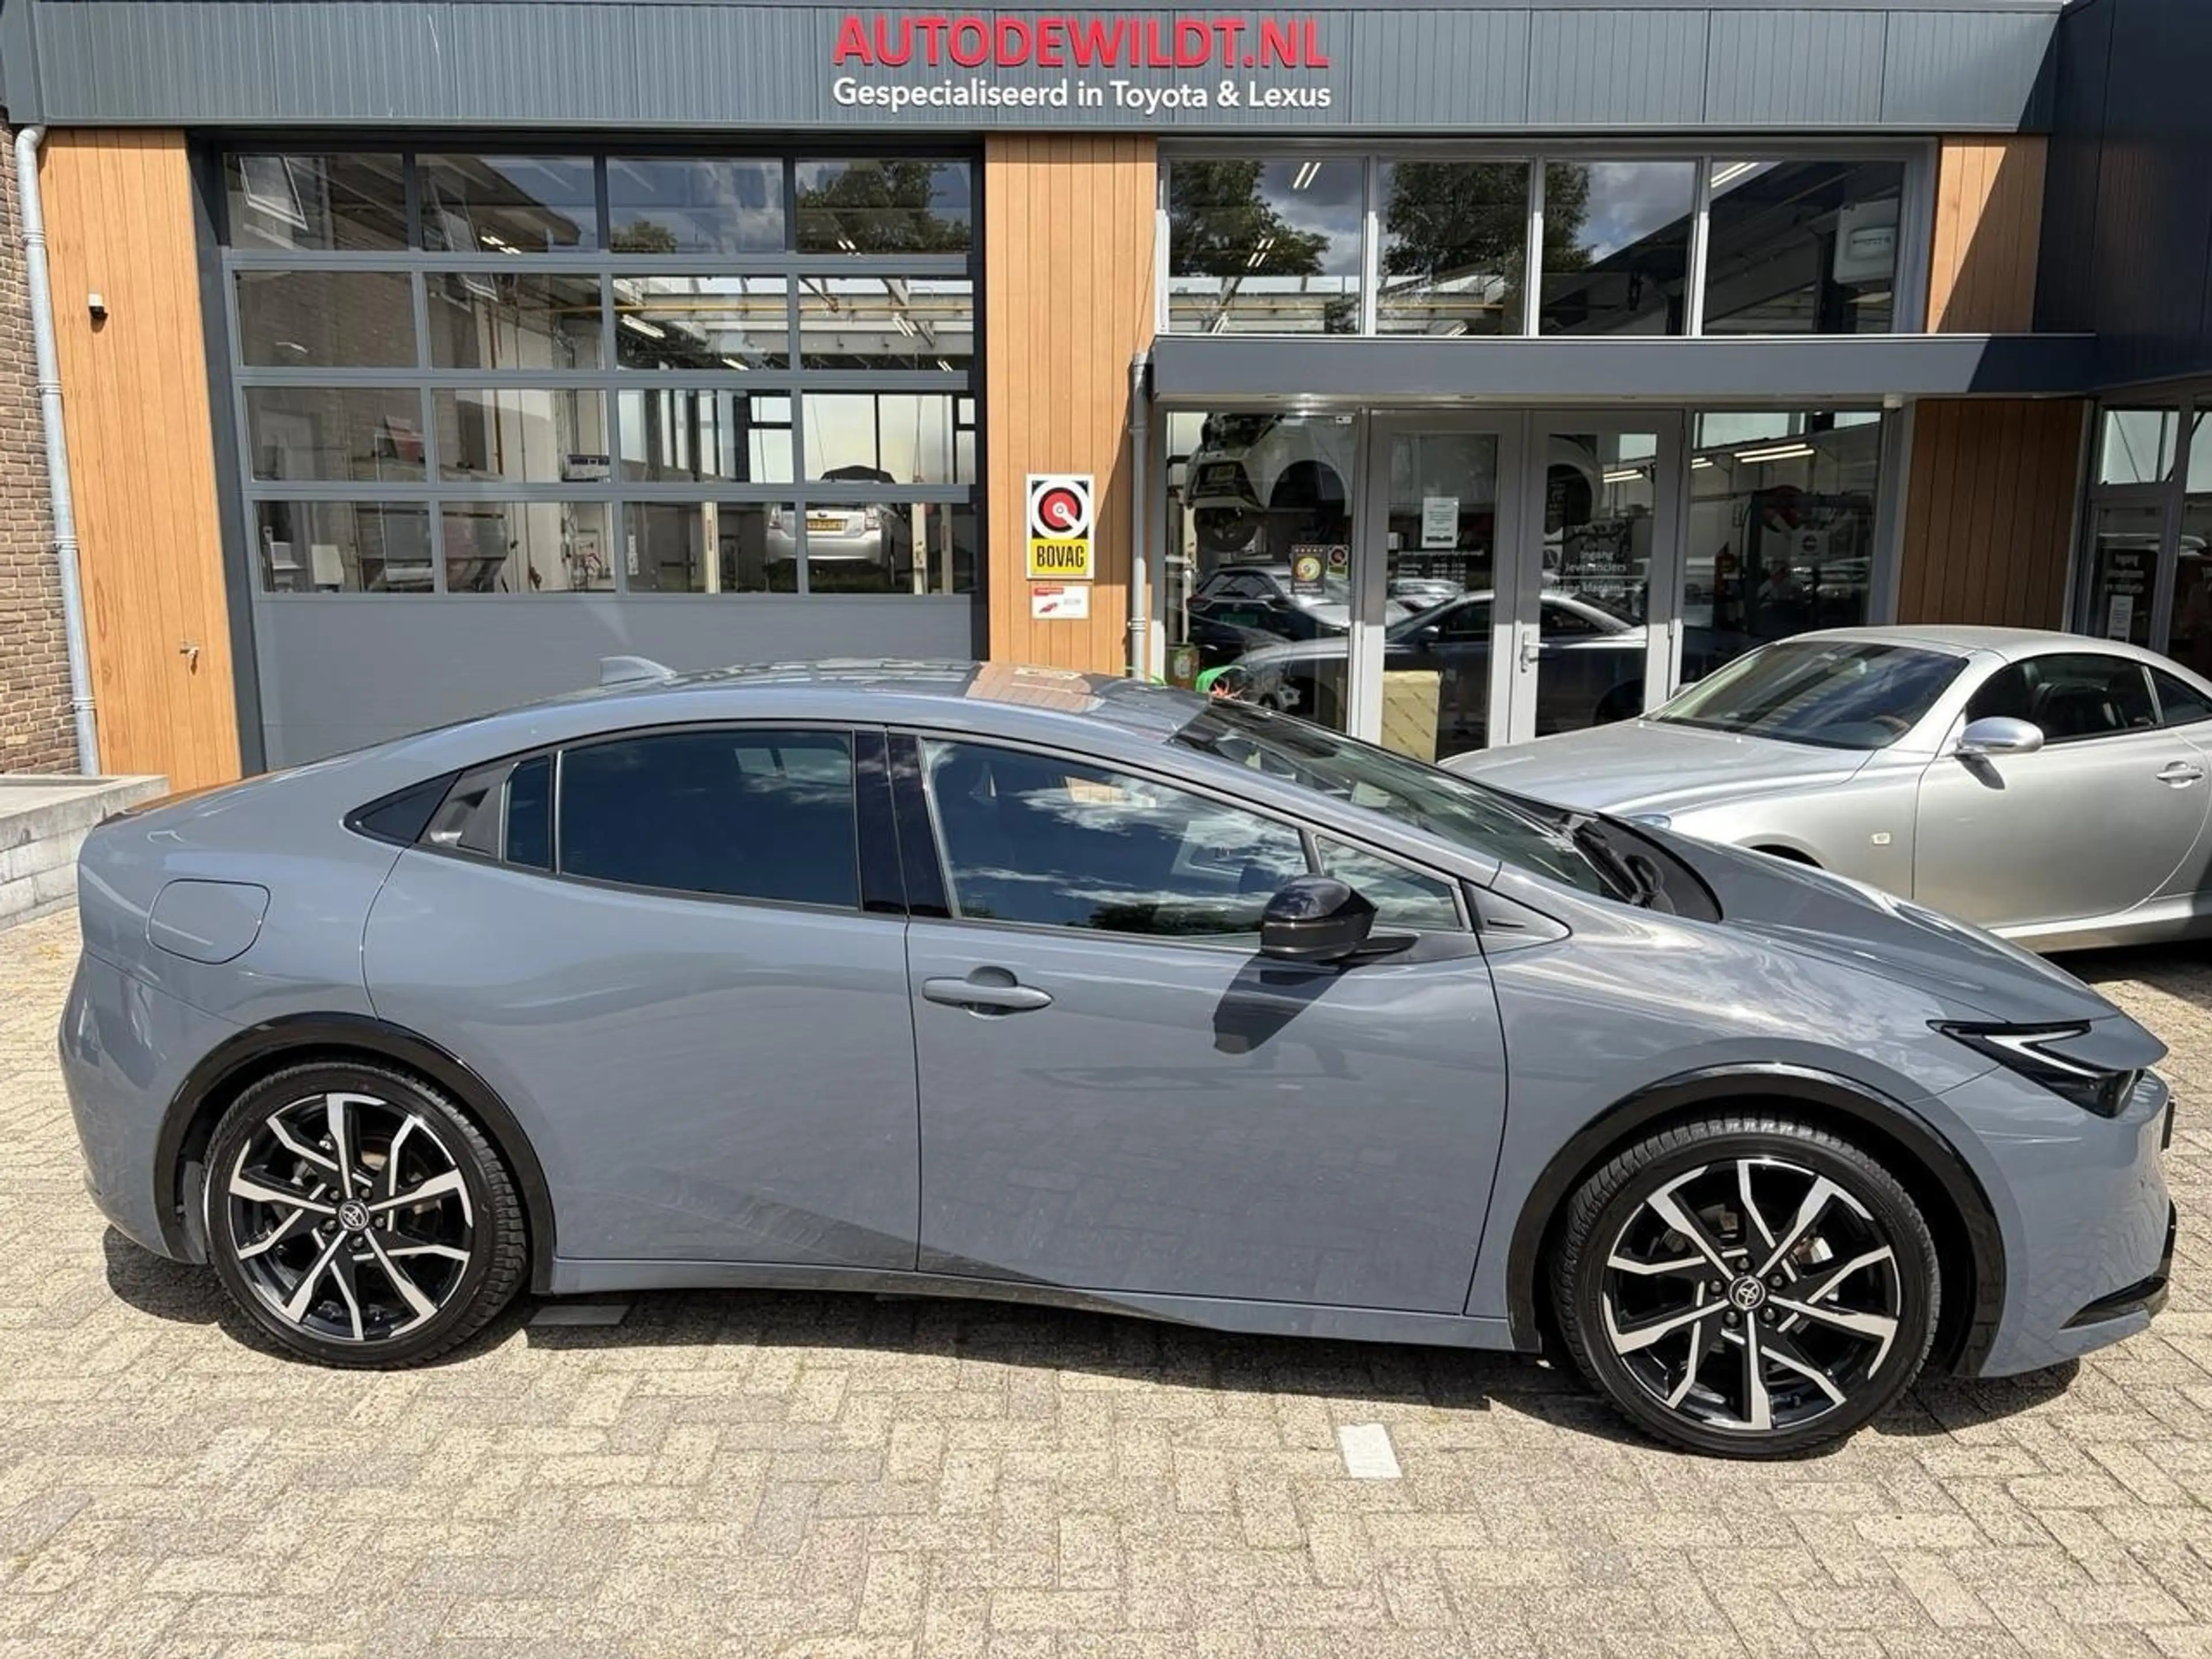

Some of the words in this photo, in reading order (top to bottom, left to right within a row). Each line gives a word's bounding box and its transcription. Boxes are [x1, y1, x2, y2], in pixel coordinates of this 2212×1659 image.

[834, 16, 1330, 68] AUTODEWILDT.NL
[834, 77, 1068, 112] Gespecialiseerd
[1078, 81, 1103, 106] in
[1109, 80, 1207, 113] Toyota
[1217, 81, 1240, 107] &
[1249, 81, 1331, 107] Lexus
[1036, 545, 1084, 568] BOVAG
